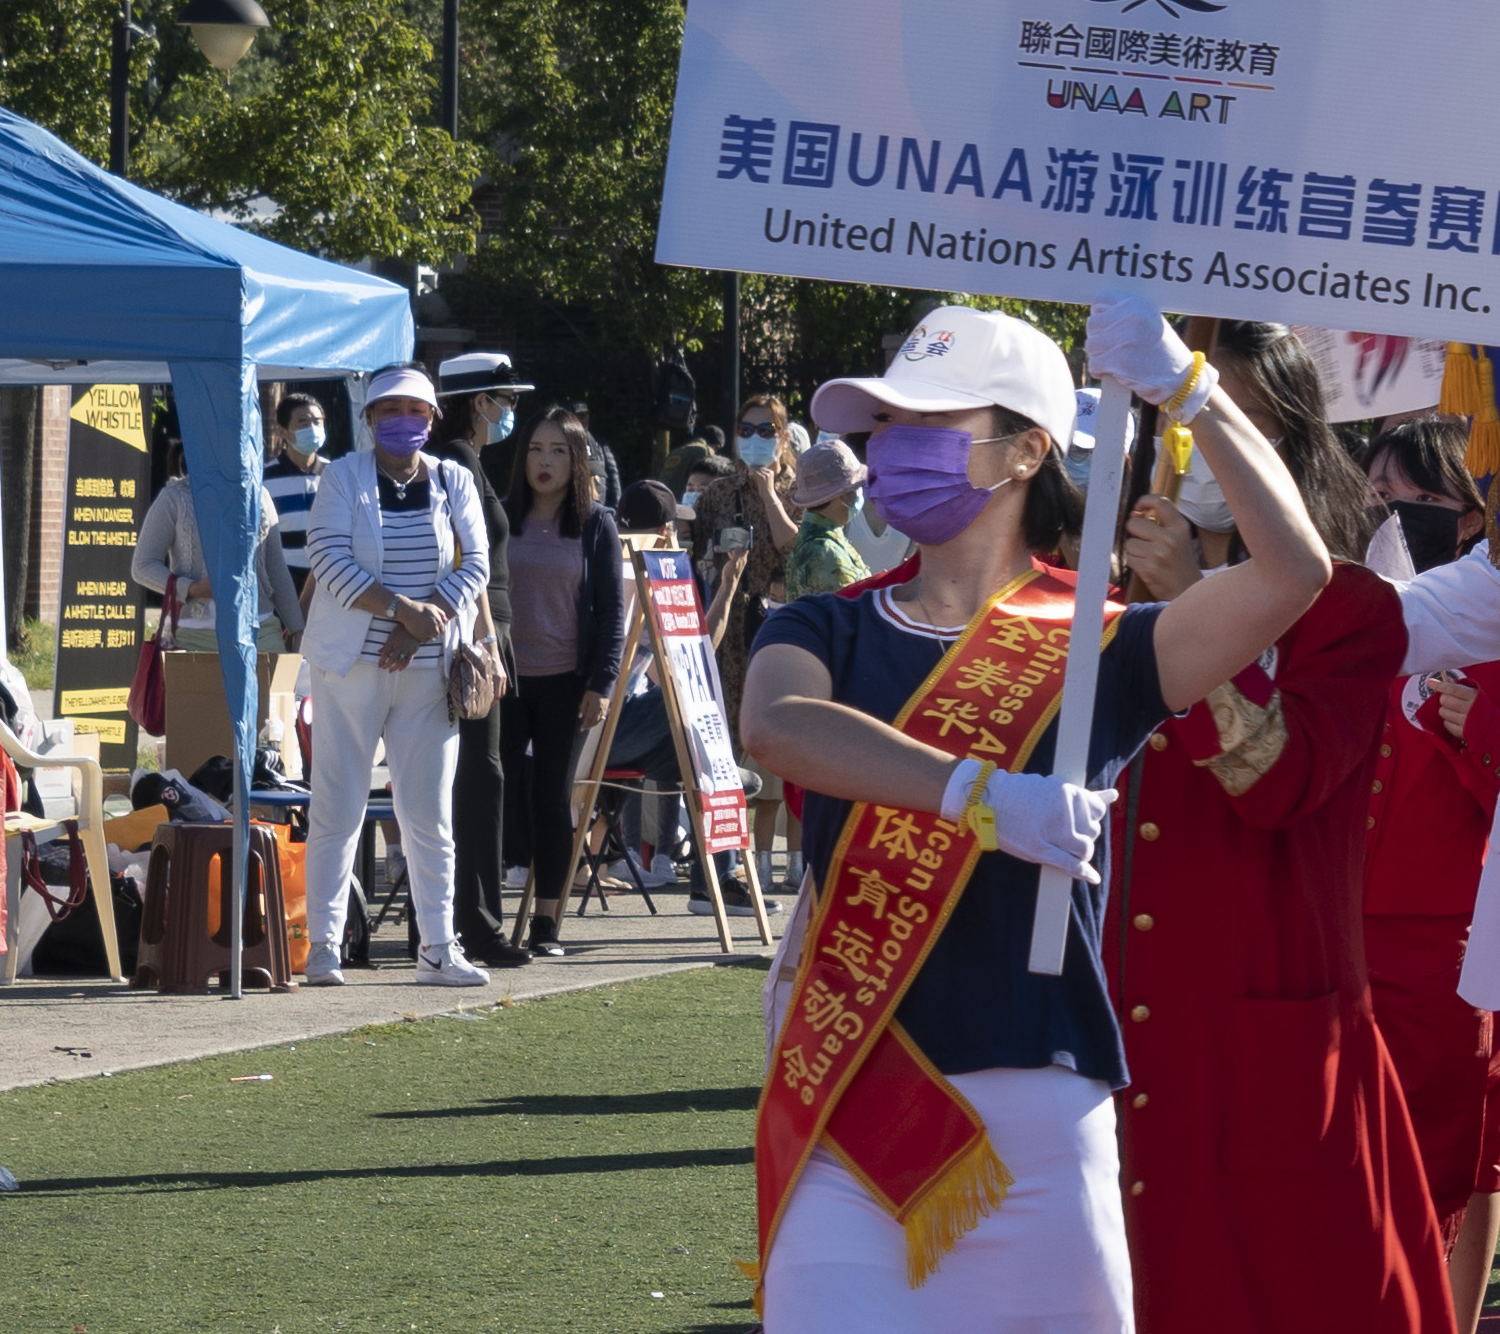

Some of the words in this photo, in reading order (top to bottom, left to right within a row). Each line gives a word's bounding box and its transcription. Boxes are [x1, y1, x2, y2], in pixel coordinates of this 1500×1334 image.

[1019, 21, 1280, 76] 聯合國際美術教育
[1047, 79, 1148, 117] UNAA
[1159, 90, 1237, 124] ART
[764, 207, 895, 254] United
[907, 220, 1057, 269] Nations
[1067, 238, 1193, 282] Artists
[1204, 251, 1410, 305] Associates
[1423, 273, 1491, 314] Inc.
[86, 410, 141, 430] WHISTLE
[88, 389, 140, 408] YELLOW
[989, 628, 1071, 725] Chinese
[855, 896, 928, 1006] Sports
[800, 1011, 863, 1105] Game
